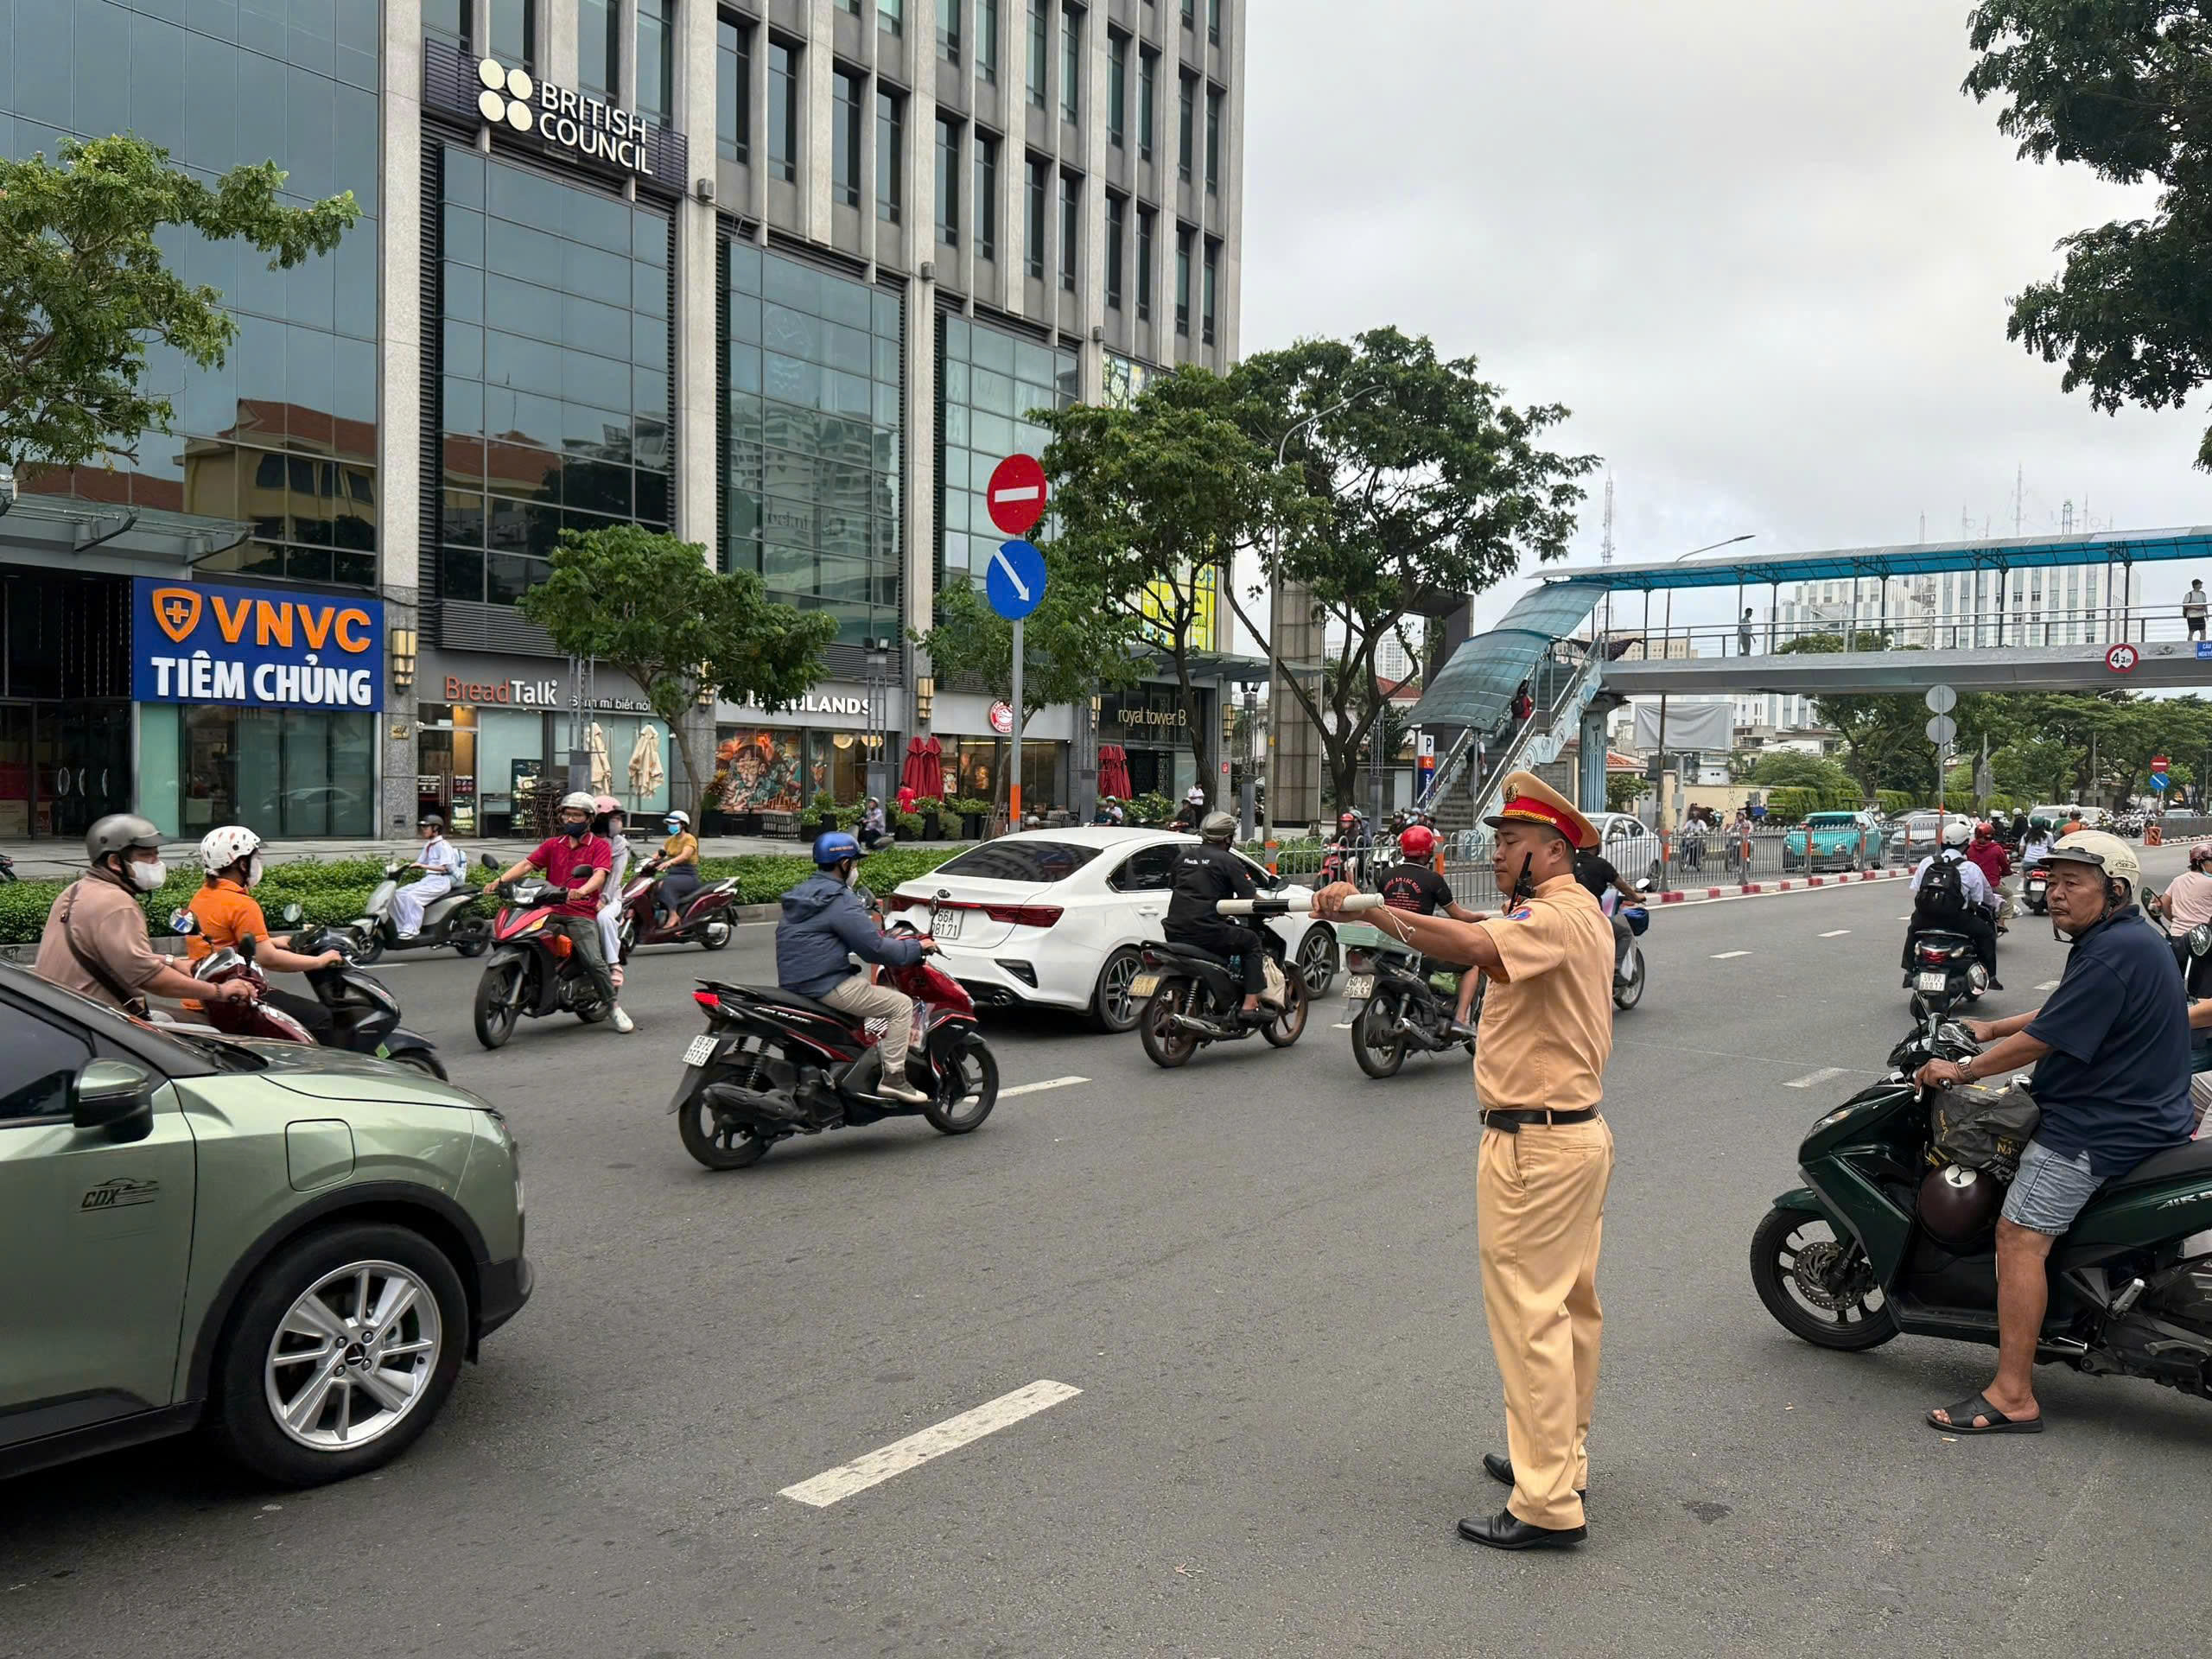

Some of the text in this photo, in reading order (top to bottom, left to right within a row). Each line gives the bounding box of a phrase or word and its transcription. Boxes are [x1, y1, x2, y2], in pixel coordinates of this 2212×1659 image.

[541, 81, 646, 144] BRITISH
[539, 112, 653, 175] COUNCIL
[210, 595, 372, 653] VNVC
[151, 650, 372, 707] TIÊM CHỦNG
[445, 677, 558, 705] BreadTalk
[1118, 706, 1186, 727] royal tower B
[938, 910, 954, 923] 66A
